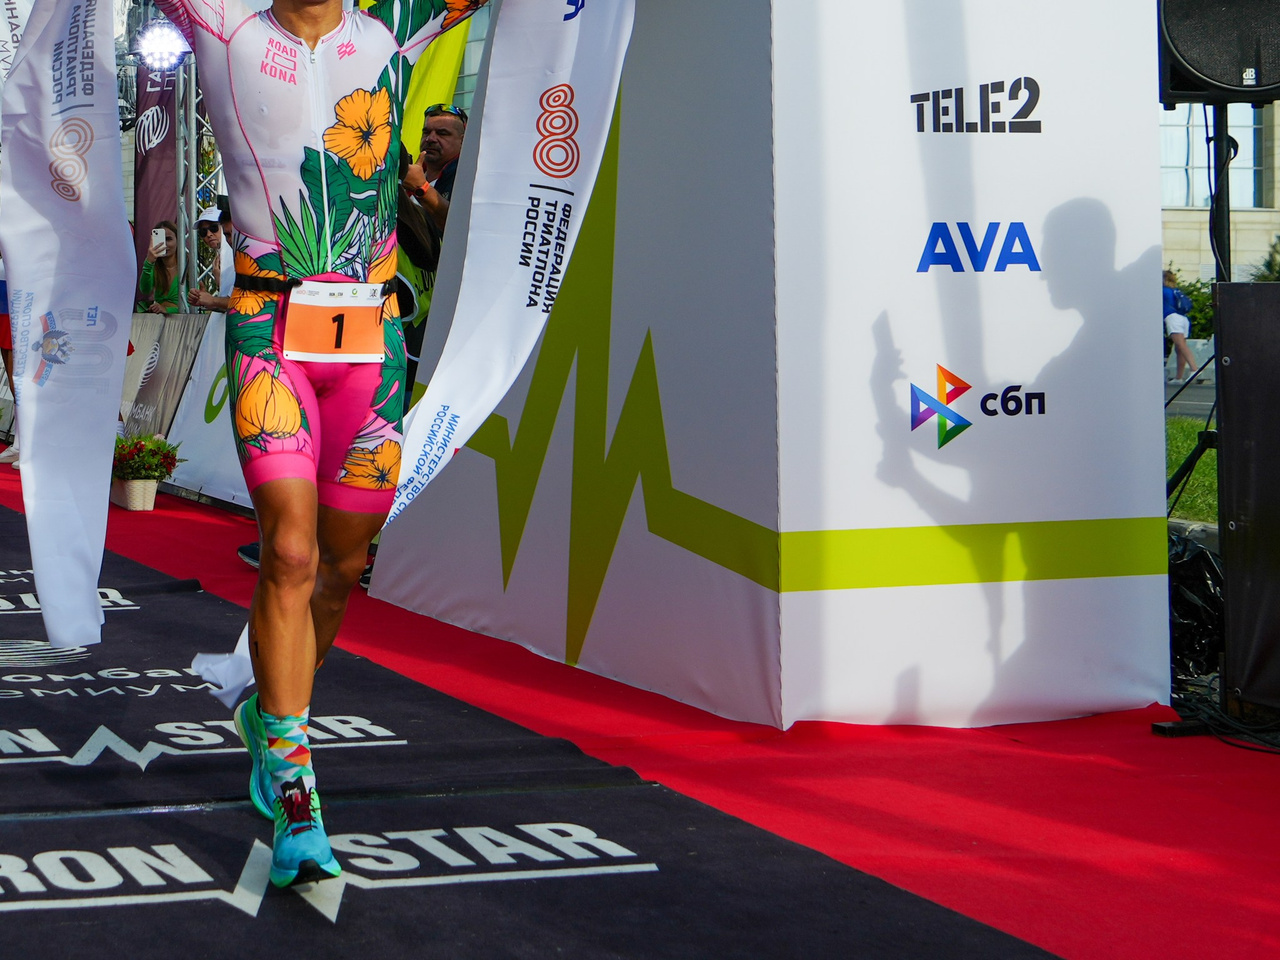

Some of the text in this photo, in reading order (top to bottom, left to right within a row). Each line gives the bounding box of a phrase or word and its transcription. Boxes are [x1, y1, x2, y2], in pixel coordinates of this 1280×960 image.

[260, 60, 297, 86] KONA
[268, 37, 297, 59] ROAD
[910, 76, 1042, 134] TELE2
[518, 196, 541, 268] РОССИИ
[525, 199, 559, 308] ТРИАТЛОНА
[542, 202, 573, 314] ФЕДЕРАЦИЯ
[916, 221, 1042, 273] AVA
[331, 313, 345, 350] 1
[979, 385, 1046, 417] сбп
[406, 413, 461, 502] МИНИСТЕРСТВО
[413, 404, 450, 476] РОССИЙСКОЙ
[326, 822, 638, 872] STAR
